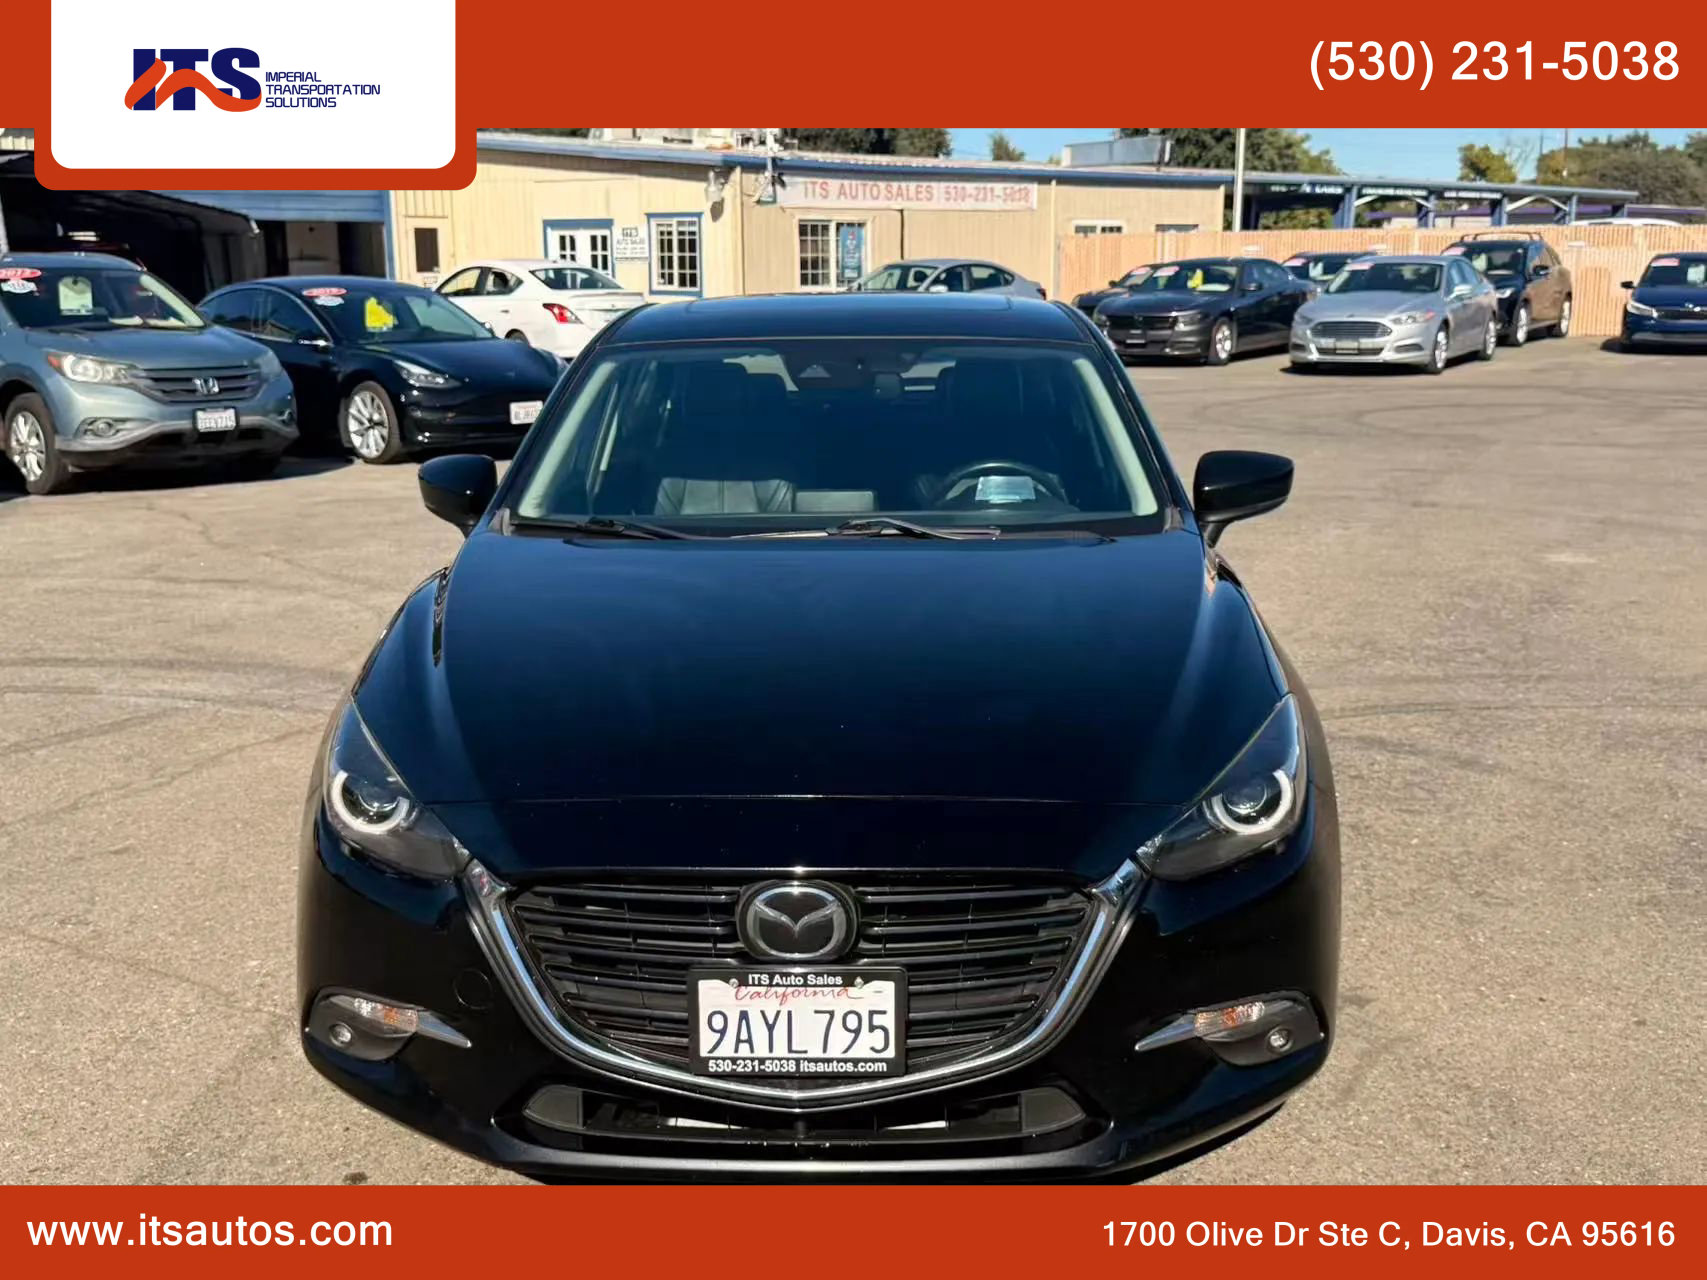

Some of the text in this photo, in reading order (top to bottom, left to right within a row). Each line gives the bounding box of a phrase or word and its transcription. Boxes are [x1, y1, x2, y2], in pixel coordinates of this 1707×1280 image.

[803, 180, 1031, 204] ITS AUTO SALES 530-231-5038
[748, 973, 844, 986] ITS Auto Sales
[734, 985, 865, 1006] California
[707, 1009, 890, 1054] 9AYL795
[708, 1059, 888, 1073] 530-231-5038 itsautos.com
